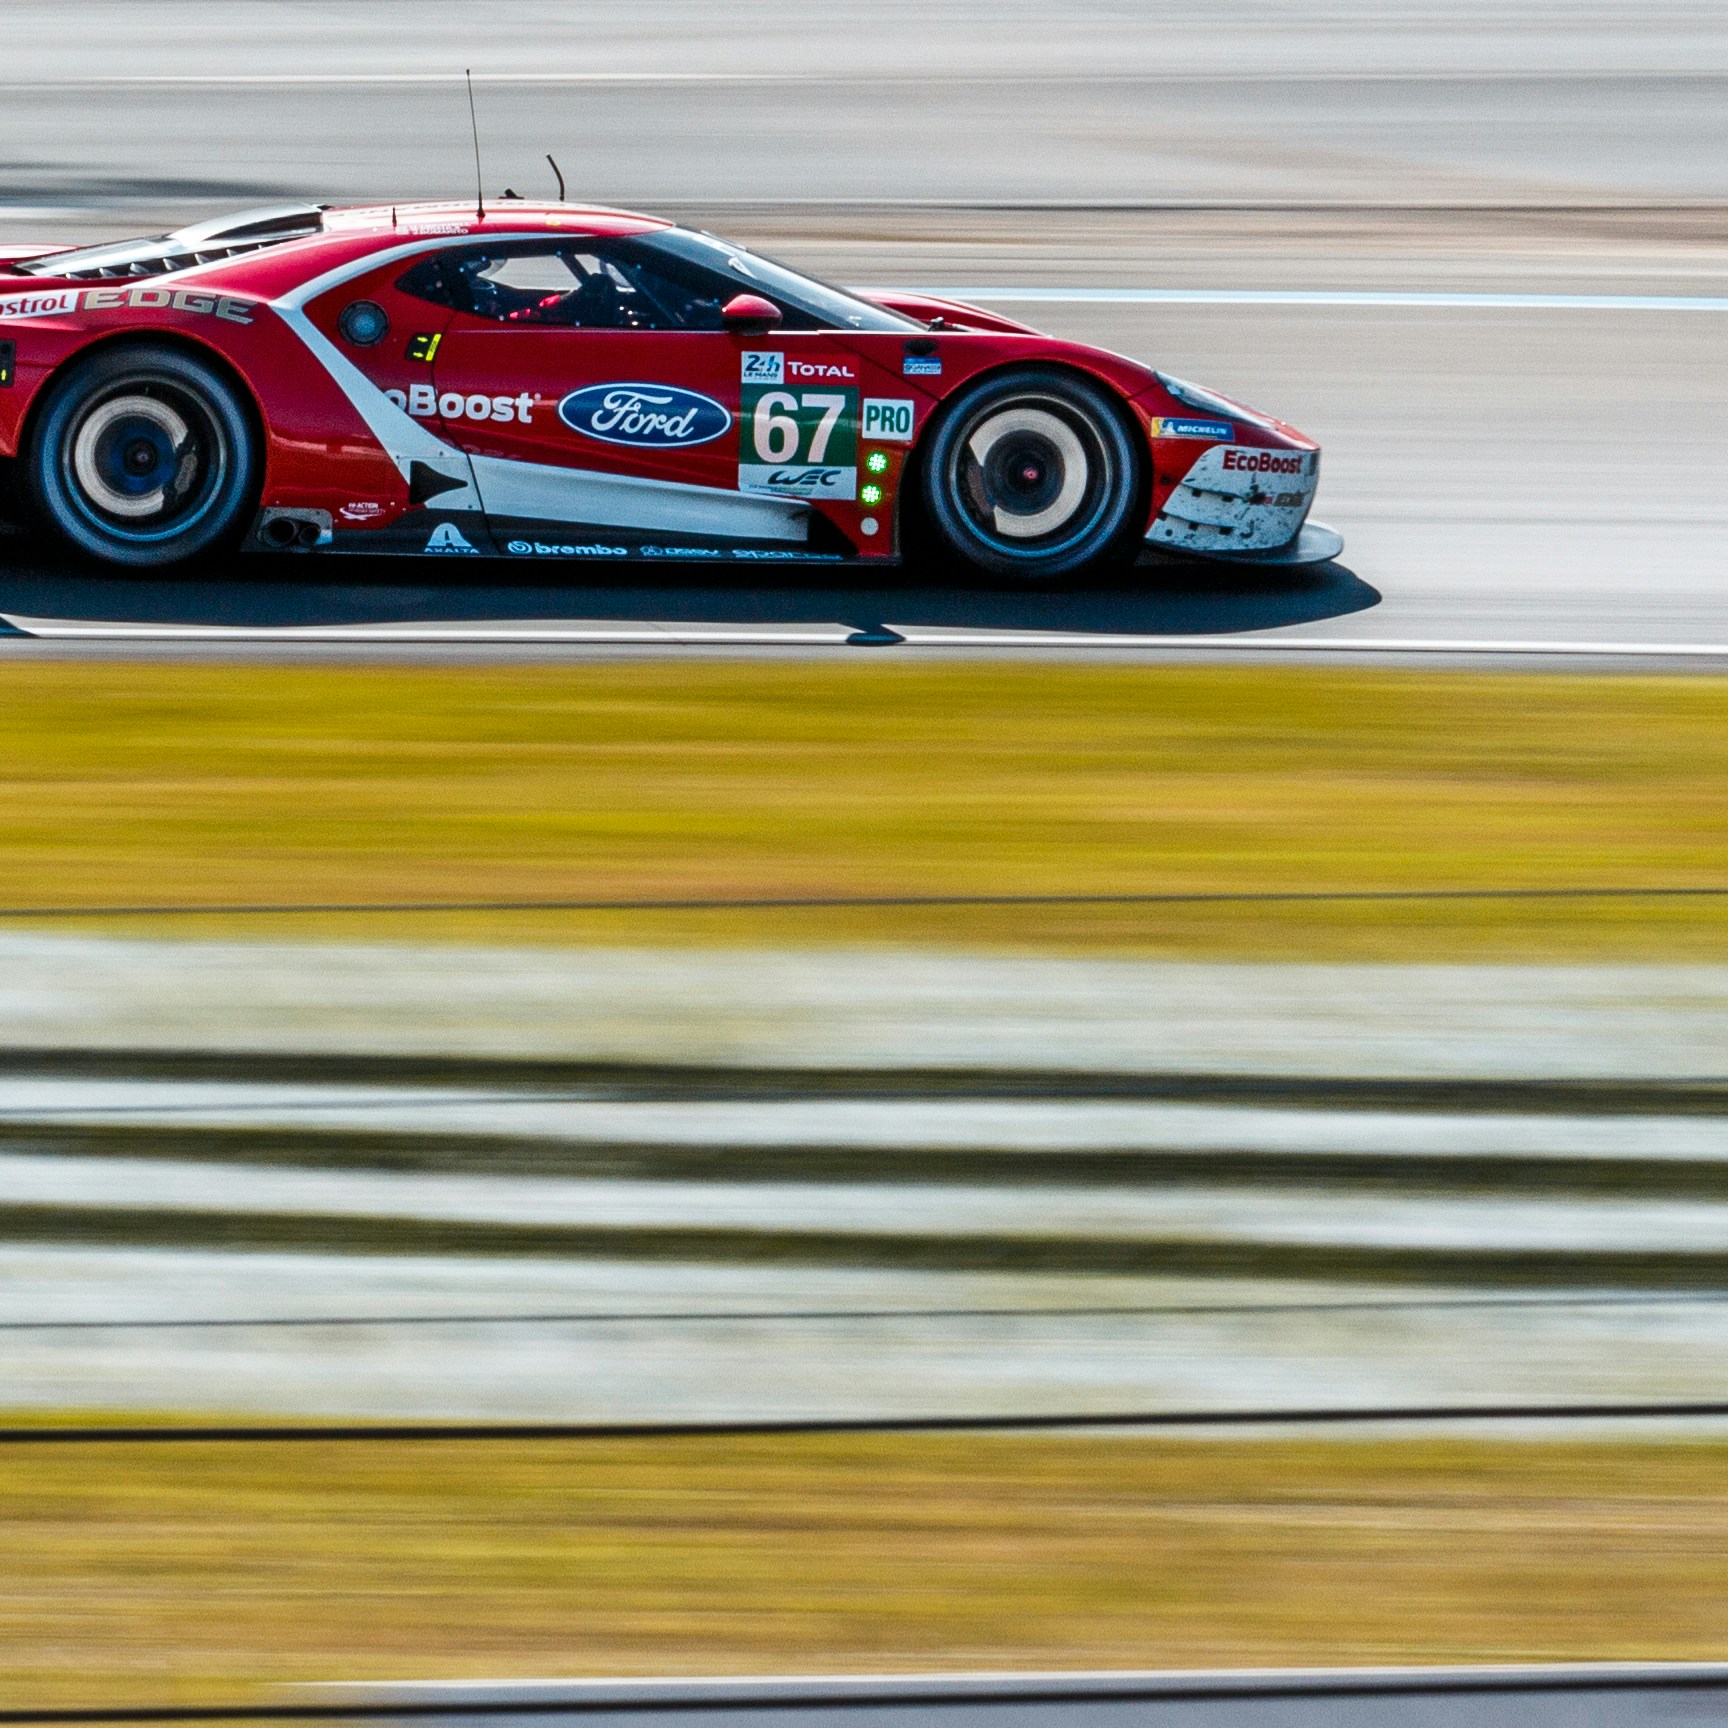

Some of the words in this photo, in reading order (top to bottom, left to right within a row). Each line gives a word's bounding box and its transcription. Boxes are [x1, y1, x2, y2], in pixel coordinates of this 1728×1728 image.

[82, 287, 258, 324] EDGE
[787, 361, 855, 378] TOTAL
[591, 390, 699, 438] Ford
[865, 405, 911, 434] PRO
[753, 391, 846, 463] 67
[1177, 425, 1228, 436] MICHELIN
[1223, 450, 1304, 474] EcoBoost
[767, 468, 842, 486] WEC
[534, 542, 628, 555] brembo
